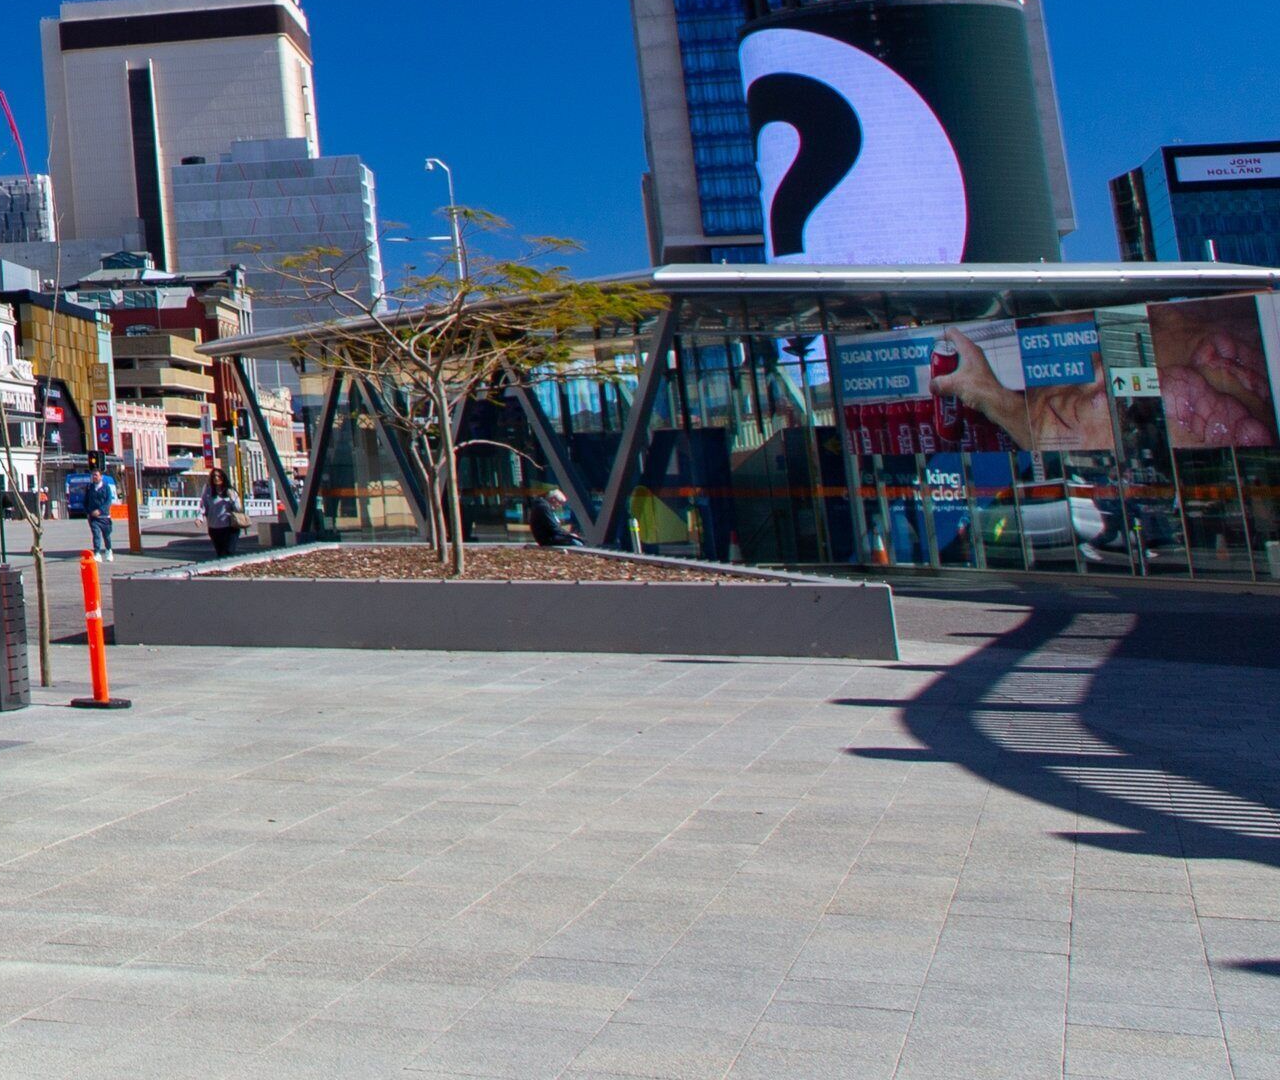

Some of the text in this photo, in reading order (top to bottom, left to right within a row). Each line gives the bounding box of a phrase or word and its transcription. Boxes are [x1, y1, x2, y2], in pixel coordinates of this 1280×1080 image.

[1229, 158, 1261, 166] JOHN
[1207, 167, 1262, 176] HOLLAND
[1022, 332, 1050, 349] GETS
[1052, 329, 1098, 346] TURNED
[841, 344, 928, 364] SUGAR YOUR BODY
[1026, 361, 1085, 379] TOXIC FAT
[844, 374, 910, 391] DOESN'T NEED
